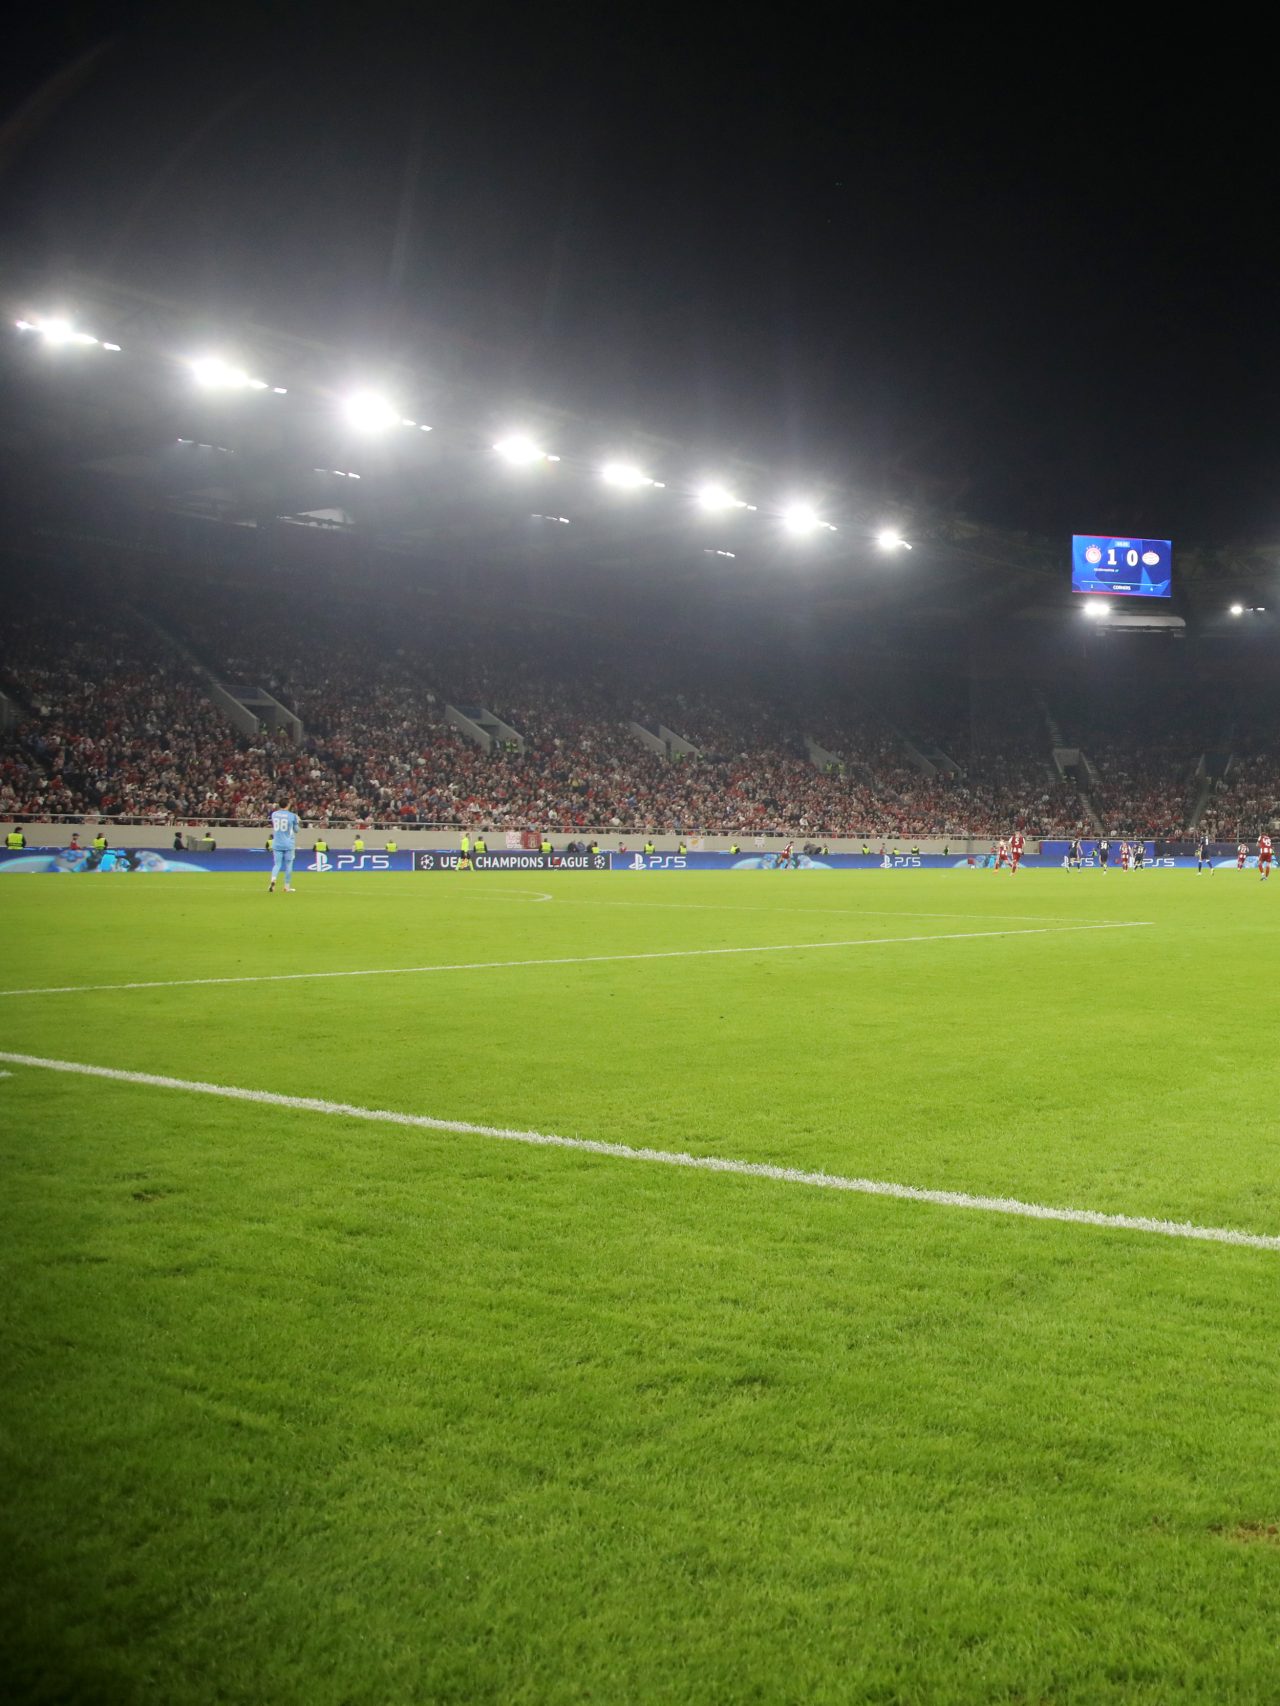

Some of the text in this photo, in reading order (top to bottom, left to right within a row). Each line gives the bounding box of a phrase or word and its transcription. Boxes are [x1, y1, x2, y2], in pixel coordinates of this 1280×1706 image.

[1107, 549, 1139, 567] 1 0
[273, 818, 288, 832] 88
[337, 855, 390, 869] PS5
[475, 856, 544, 868] CHAMPIONS
[649, 856, 687, 868] PS5
[894, 857, 921, 867] PS5
[1142, 858, 1175, 867] PS5
